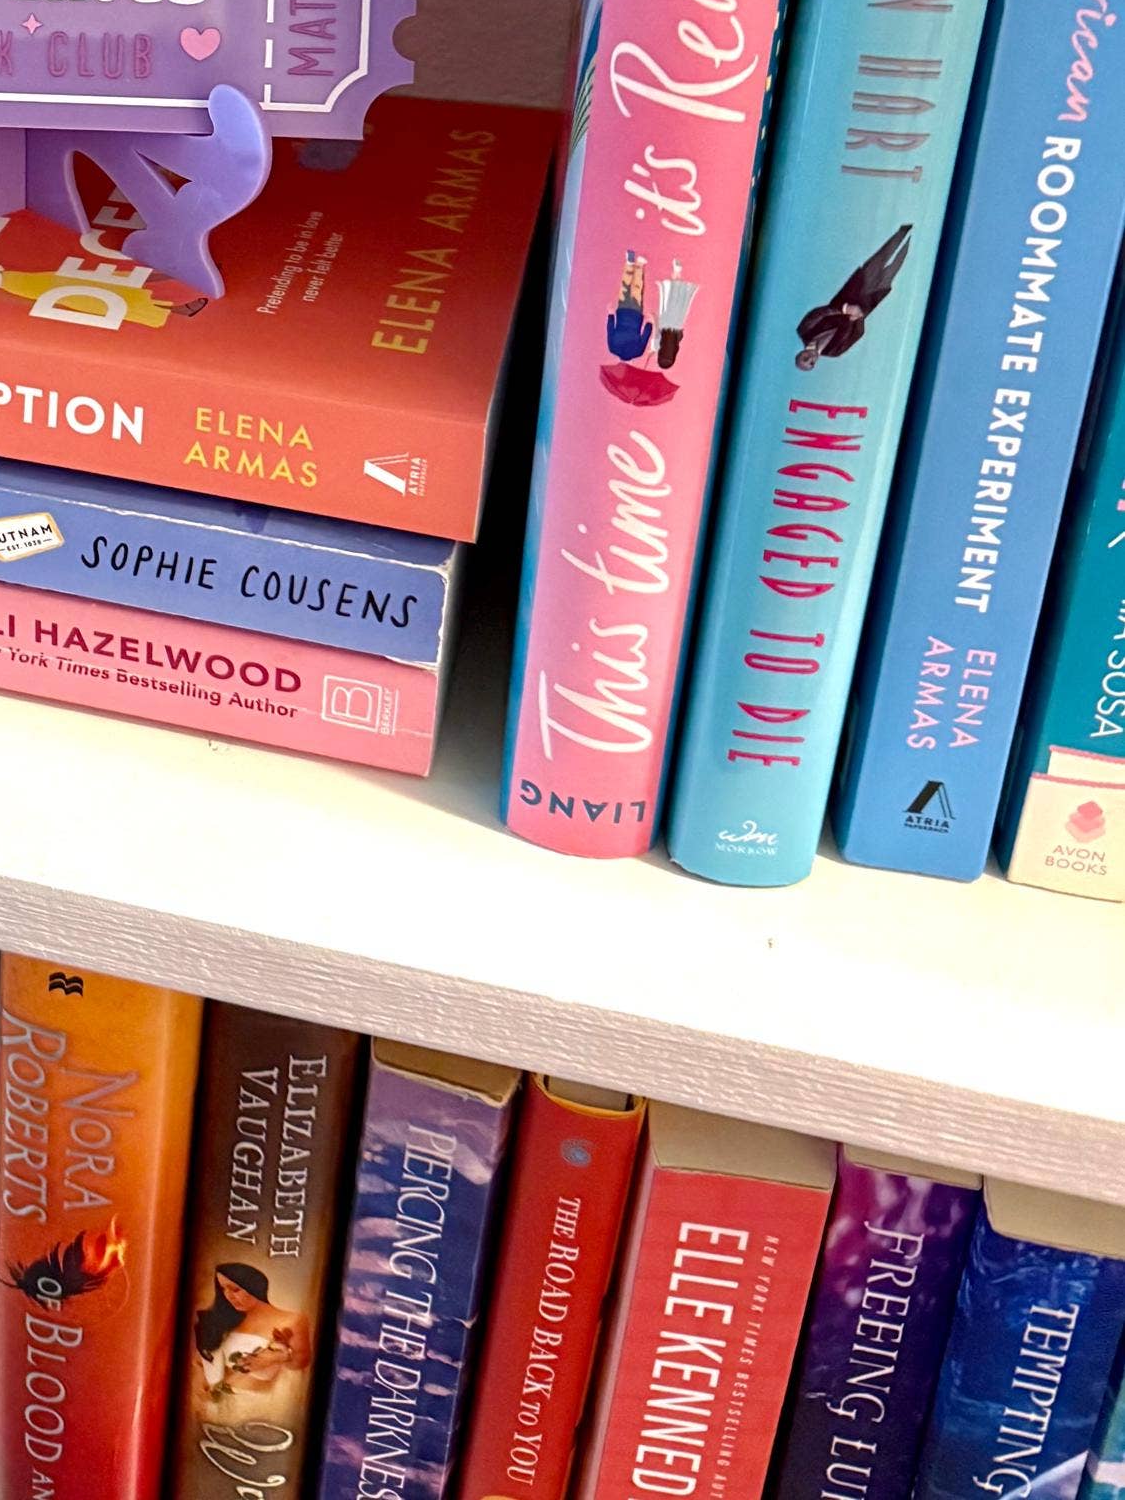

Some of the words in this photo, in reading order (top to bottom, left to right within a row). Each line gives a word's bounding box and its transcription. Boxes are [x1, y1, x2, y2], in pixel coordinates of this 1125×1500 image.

[48, 30, 154, 80] CLUB
[840, 54, 943, 184] HART
[620, 144, 708, 238] it's
[256, 265, 303, 314] Pretending
[297, 211, 323, 229] love
[303, 276, 324, 302] never
[1001, 135, 1082, 374] ROOMMATE
[183, 441, 317, 489] ARMAS
[195, 407, 315, 452] ELENA
[560, 429, 671, 597] time
[757, 397, 870, 599] ENGAGED
[953, 388, 1032, 615] EXPERIMENT
[81, 535, 218, 590] SOPHIE
[241, 565, 418, 629] COUSENS
[9, 646, 49, 669] York
[56, 656, 111, 681] Times
[116, 667, 222, 707] Bestselling
[228, 691, 299, 719] Author
[35, 619, 302, 695] HAZELWOOD
[538, 617, 655, 760] This
[743, 628, 826, 675] TO
[907, 637, 955, 750] ARMAS
[727, 700, 811, 768] DIE
[948, 649, 997, 750] ELENA
[520, 778, 646, 823] LIANG
[904, 813, 952, 827] ATRIA
[1045, 857, 1107, 876] BOOKS
[1053, 844, 1106, 862] AVON
[0, 1008, 68, 1225] ROBERTS
[49, 1062, 141, 1212] NORA
[225, 1065, 279, 1246] VAUGHAN
[269, 1053, 327, 1261] ELIZABETH
[389, 1123, 457, 1286] PIERCING
[553, 1196, 581, 1239] THE
[35, 1274, 65, 1312] OF
[536, 1239, 580, 1324] ROAD
[664, 1222, 750, 1326] ELLE
[750, 1274, 771, 1315] YORK
[761, 1236, 780, 1269] NEW
[378, 1290, 434, 1362] THE
[522, 1326, 564, 1400] BACK
[738, 1319, 763, 1368] TIMES
[826, 1220, 925, 1424] FREEING
[24, 1311, 84, 1463] BLOOD
[518, 1401, 541, 1426] TO
[717, 1373, 750, 1467] BESTSELLING
[973, 1303, 1081, 1499] TEMPTING
[506, 1432, 543, 1487] YOU
